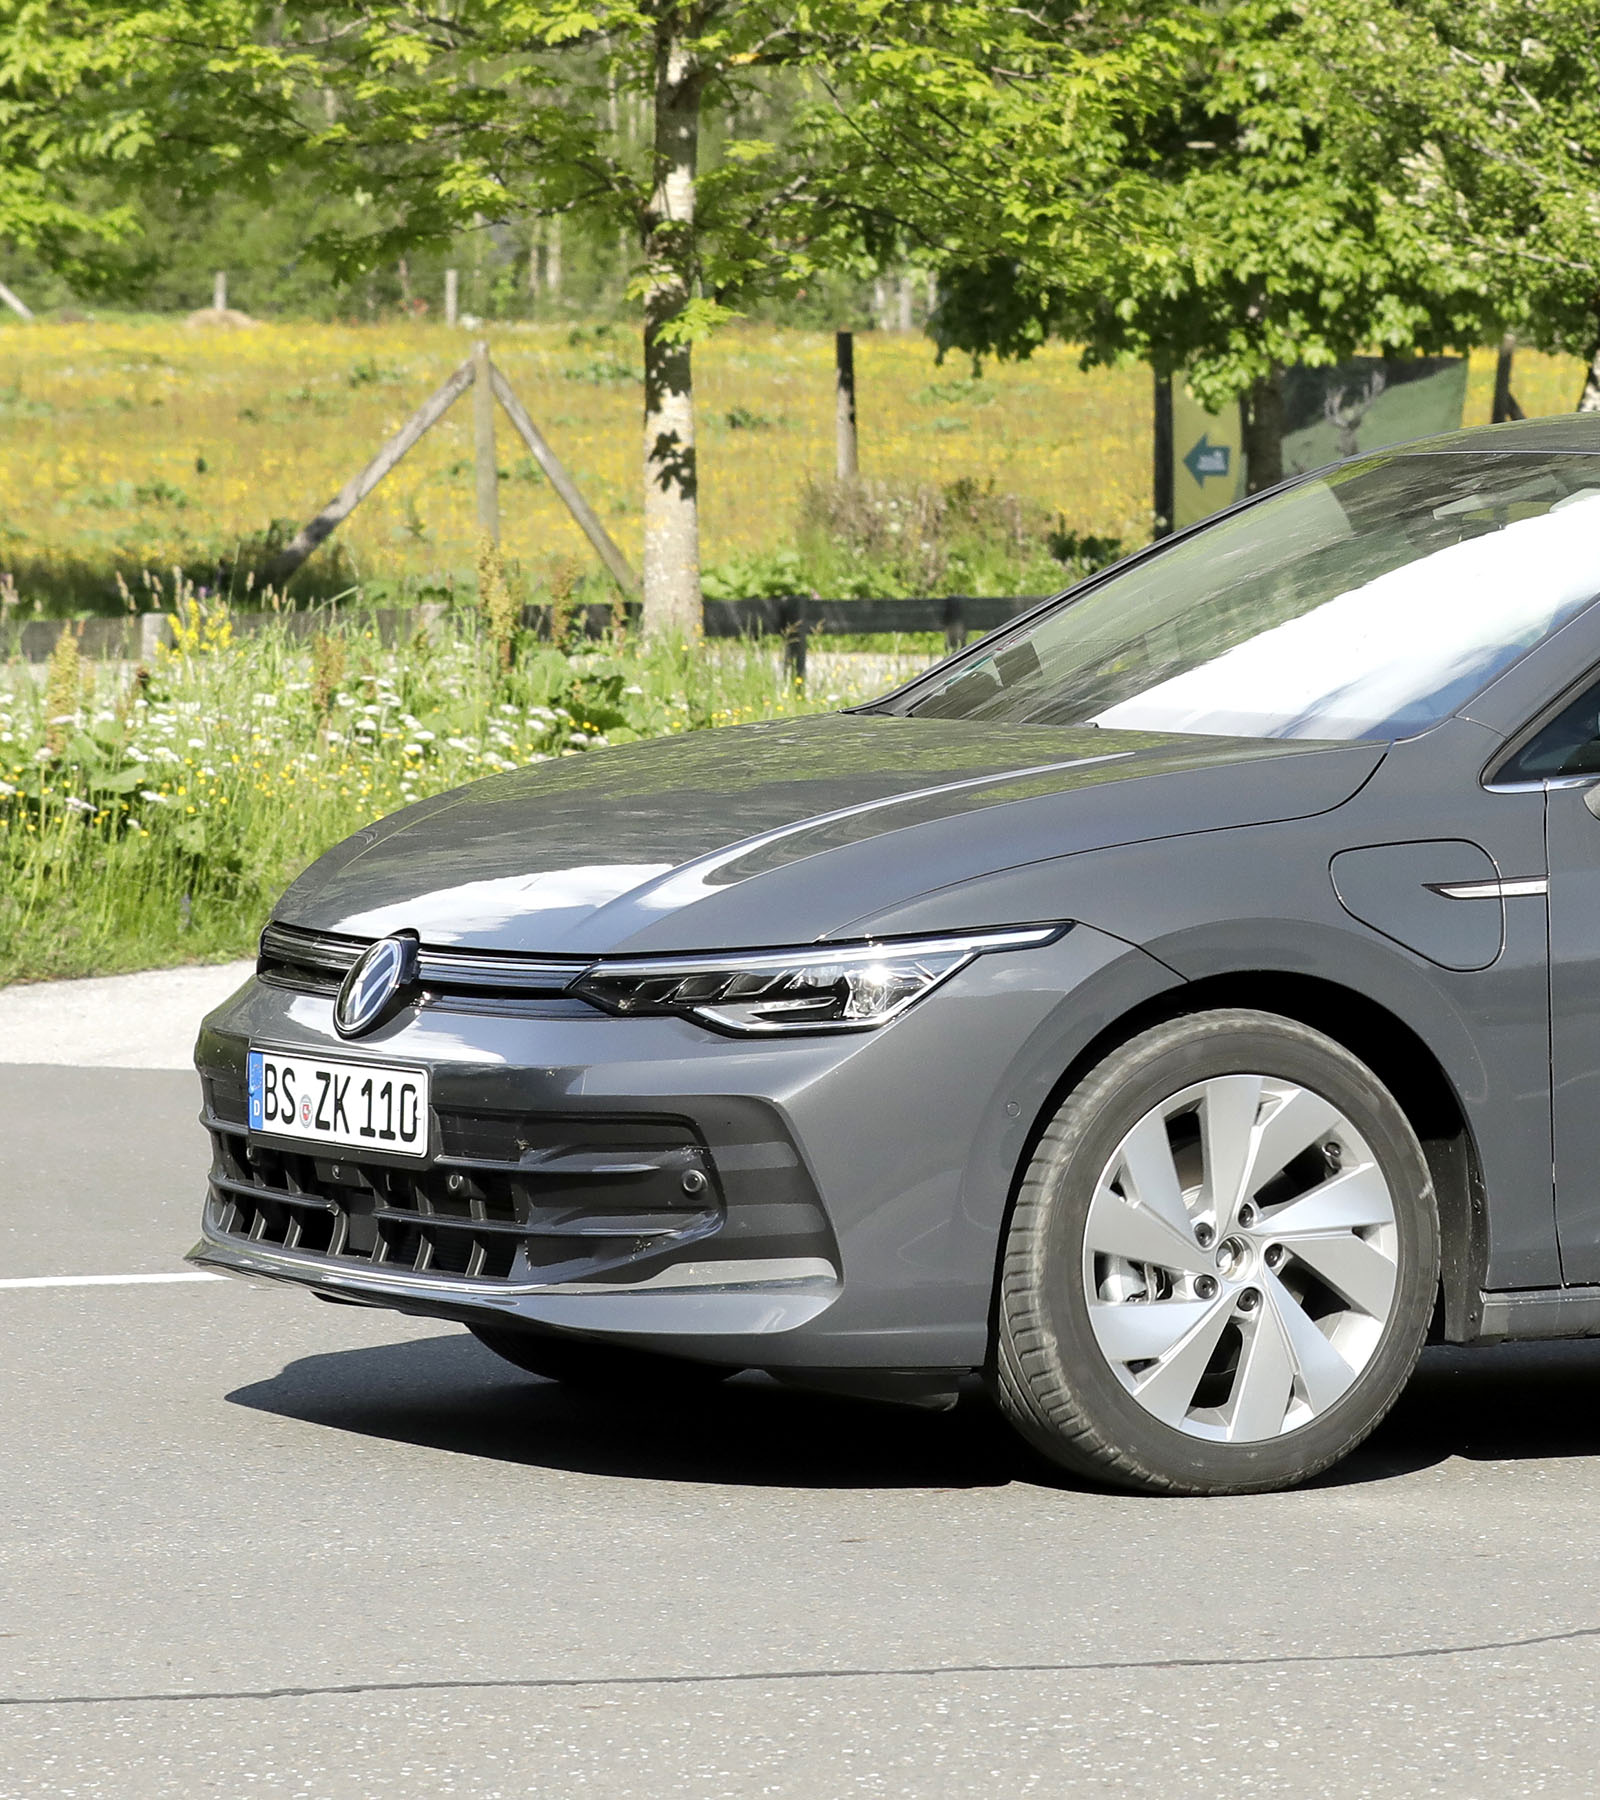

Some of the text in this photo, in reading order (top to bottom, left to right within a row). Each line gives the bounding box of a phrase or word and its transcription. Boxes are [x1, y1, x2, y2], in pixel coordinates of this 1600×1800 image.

[253, 1099, 260, 1117] D
[264, 1063, 418, 1143] BS ZK 110
